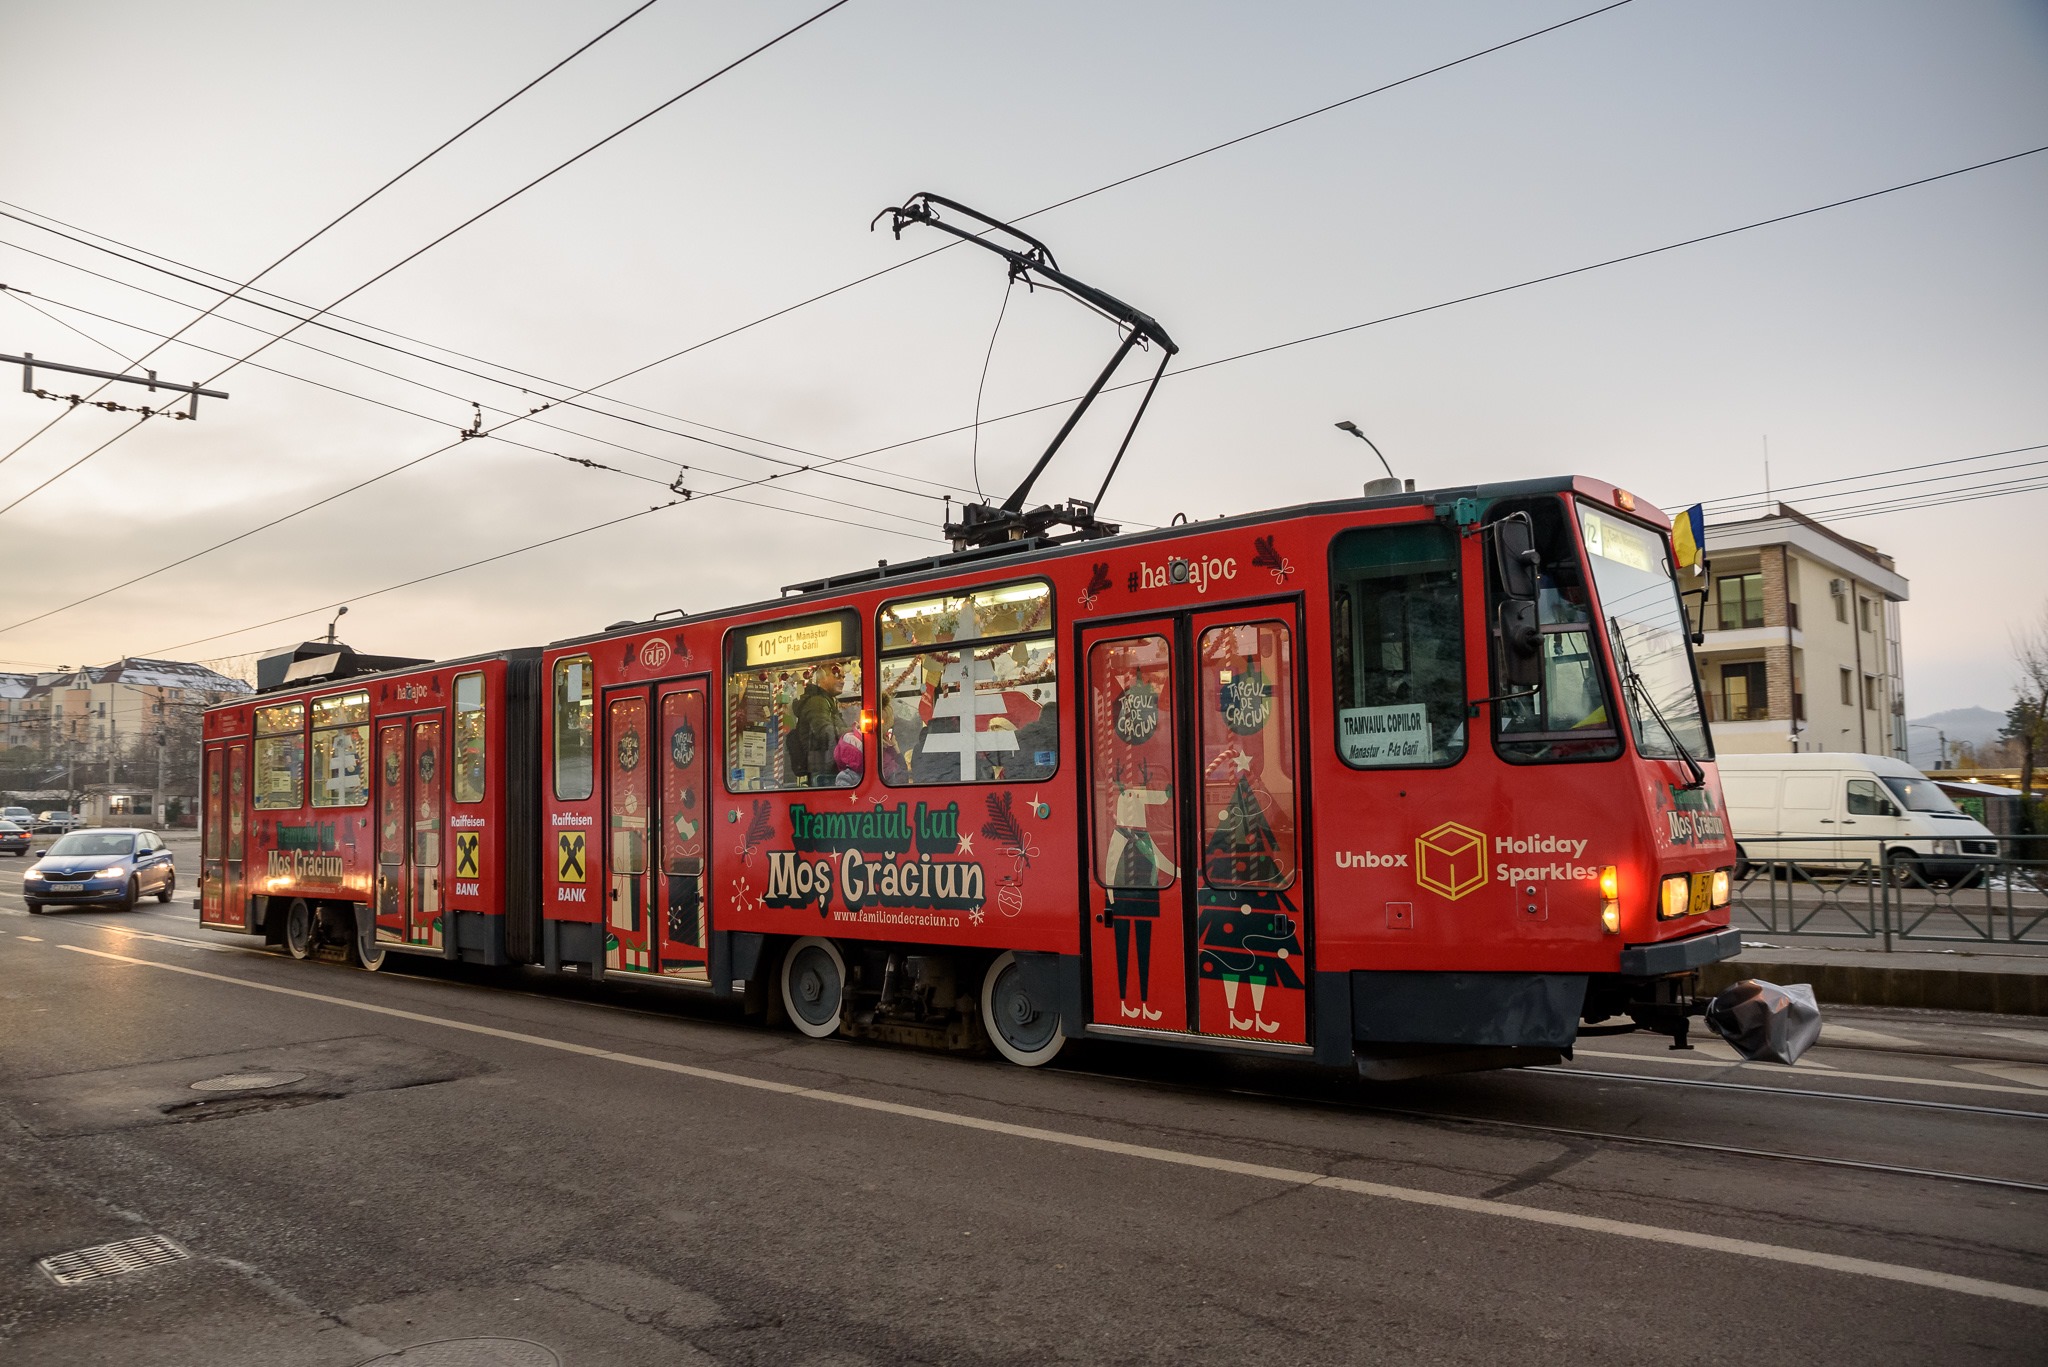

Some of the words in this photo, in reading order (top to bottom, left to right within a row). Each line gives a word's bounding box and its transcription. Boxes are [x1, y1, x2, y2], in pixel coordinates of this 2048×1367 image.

[1127, 555, 1237, 593] #haajoc
[758, 638, 777, 657] 101
[778, 635, 795, 644] Cart.
[1227, 681, 1267, 702] TÂRGUL
[1118, 694, 1153, 714] TÂRGUL
[1241, 697, 1252, 710] DE
[1131, 709, 1143, 721] DE
[1226, 701, 1270, 728] CRĂCIUN
[1344, 714, 1386, 735] TRAMVAIUL
[1387, 712, 1421, 732] COPIILOR
[1349, 744, 1380, 759] Manastur
[1387, 742, 1401, 757] P-ta
[1402, 740, 1419, 755] Garii
[451, 814, 486, 828] Raiffeisen
[551, 812, 593, 826] Raiffeisen
[791, 801, 911, 840] Tramvaiul
[919, 800, 958, 840] lui
[1495, 833, 1588, 859] Holiday
[294, 847, 343, 880] Crăciun
[1335, 850, 1409, 869] Unbox
[764, 850, 831, 909] Moș
[841, 847, 985, 902] Crăciun
[1496, 862, 1599, 887] Sparkles
[455, 882, 480, 897] BANK
[557, 887, 586, 903] BANK
[833, 908, 960, 928] www.familiondecraciun.ro
